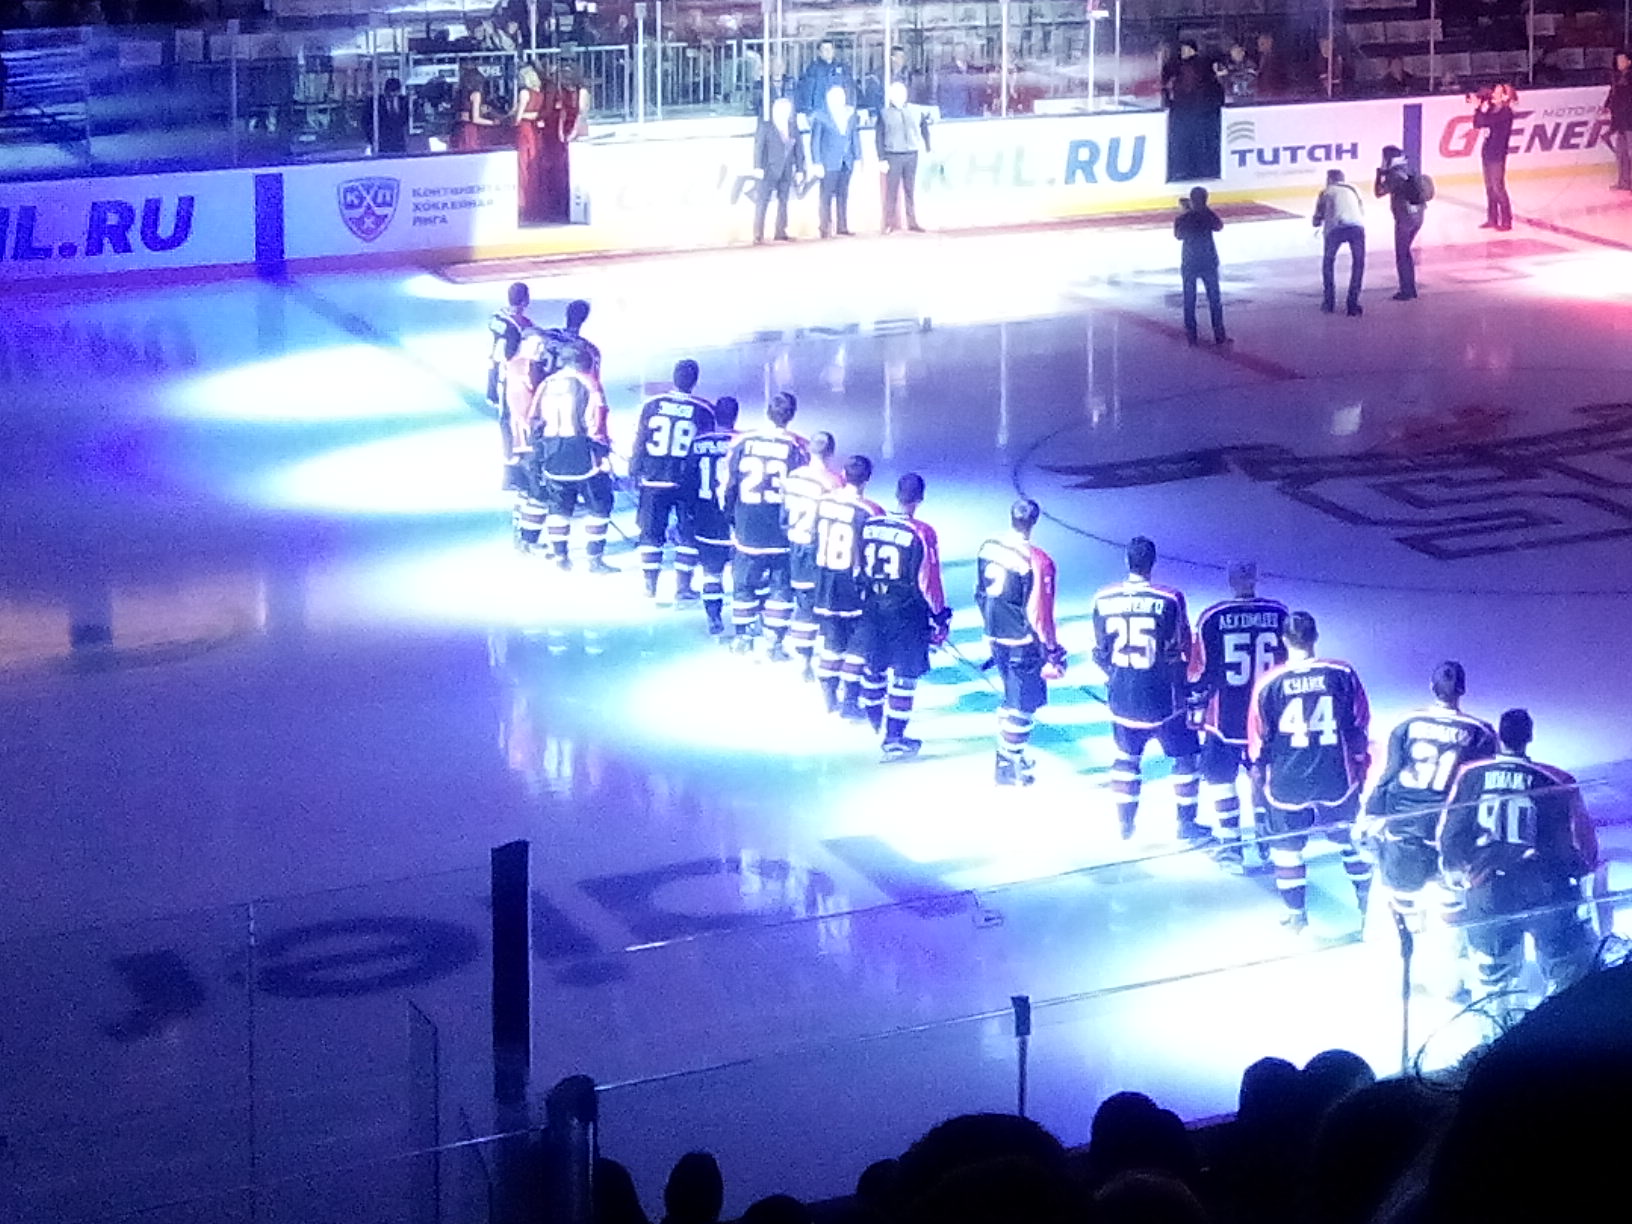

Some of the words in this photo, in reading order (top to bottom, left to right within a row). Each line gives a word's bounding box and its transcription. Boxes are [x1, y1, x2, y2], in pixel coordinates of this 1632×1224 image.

[646, 415, 698, 458] 38
[739, 456, 788, 504] 23
[1105, 616, 1157, 669] 25
[1223, 632, 1279, 686] 56
[1278, 695, 1338, 748] 44
